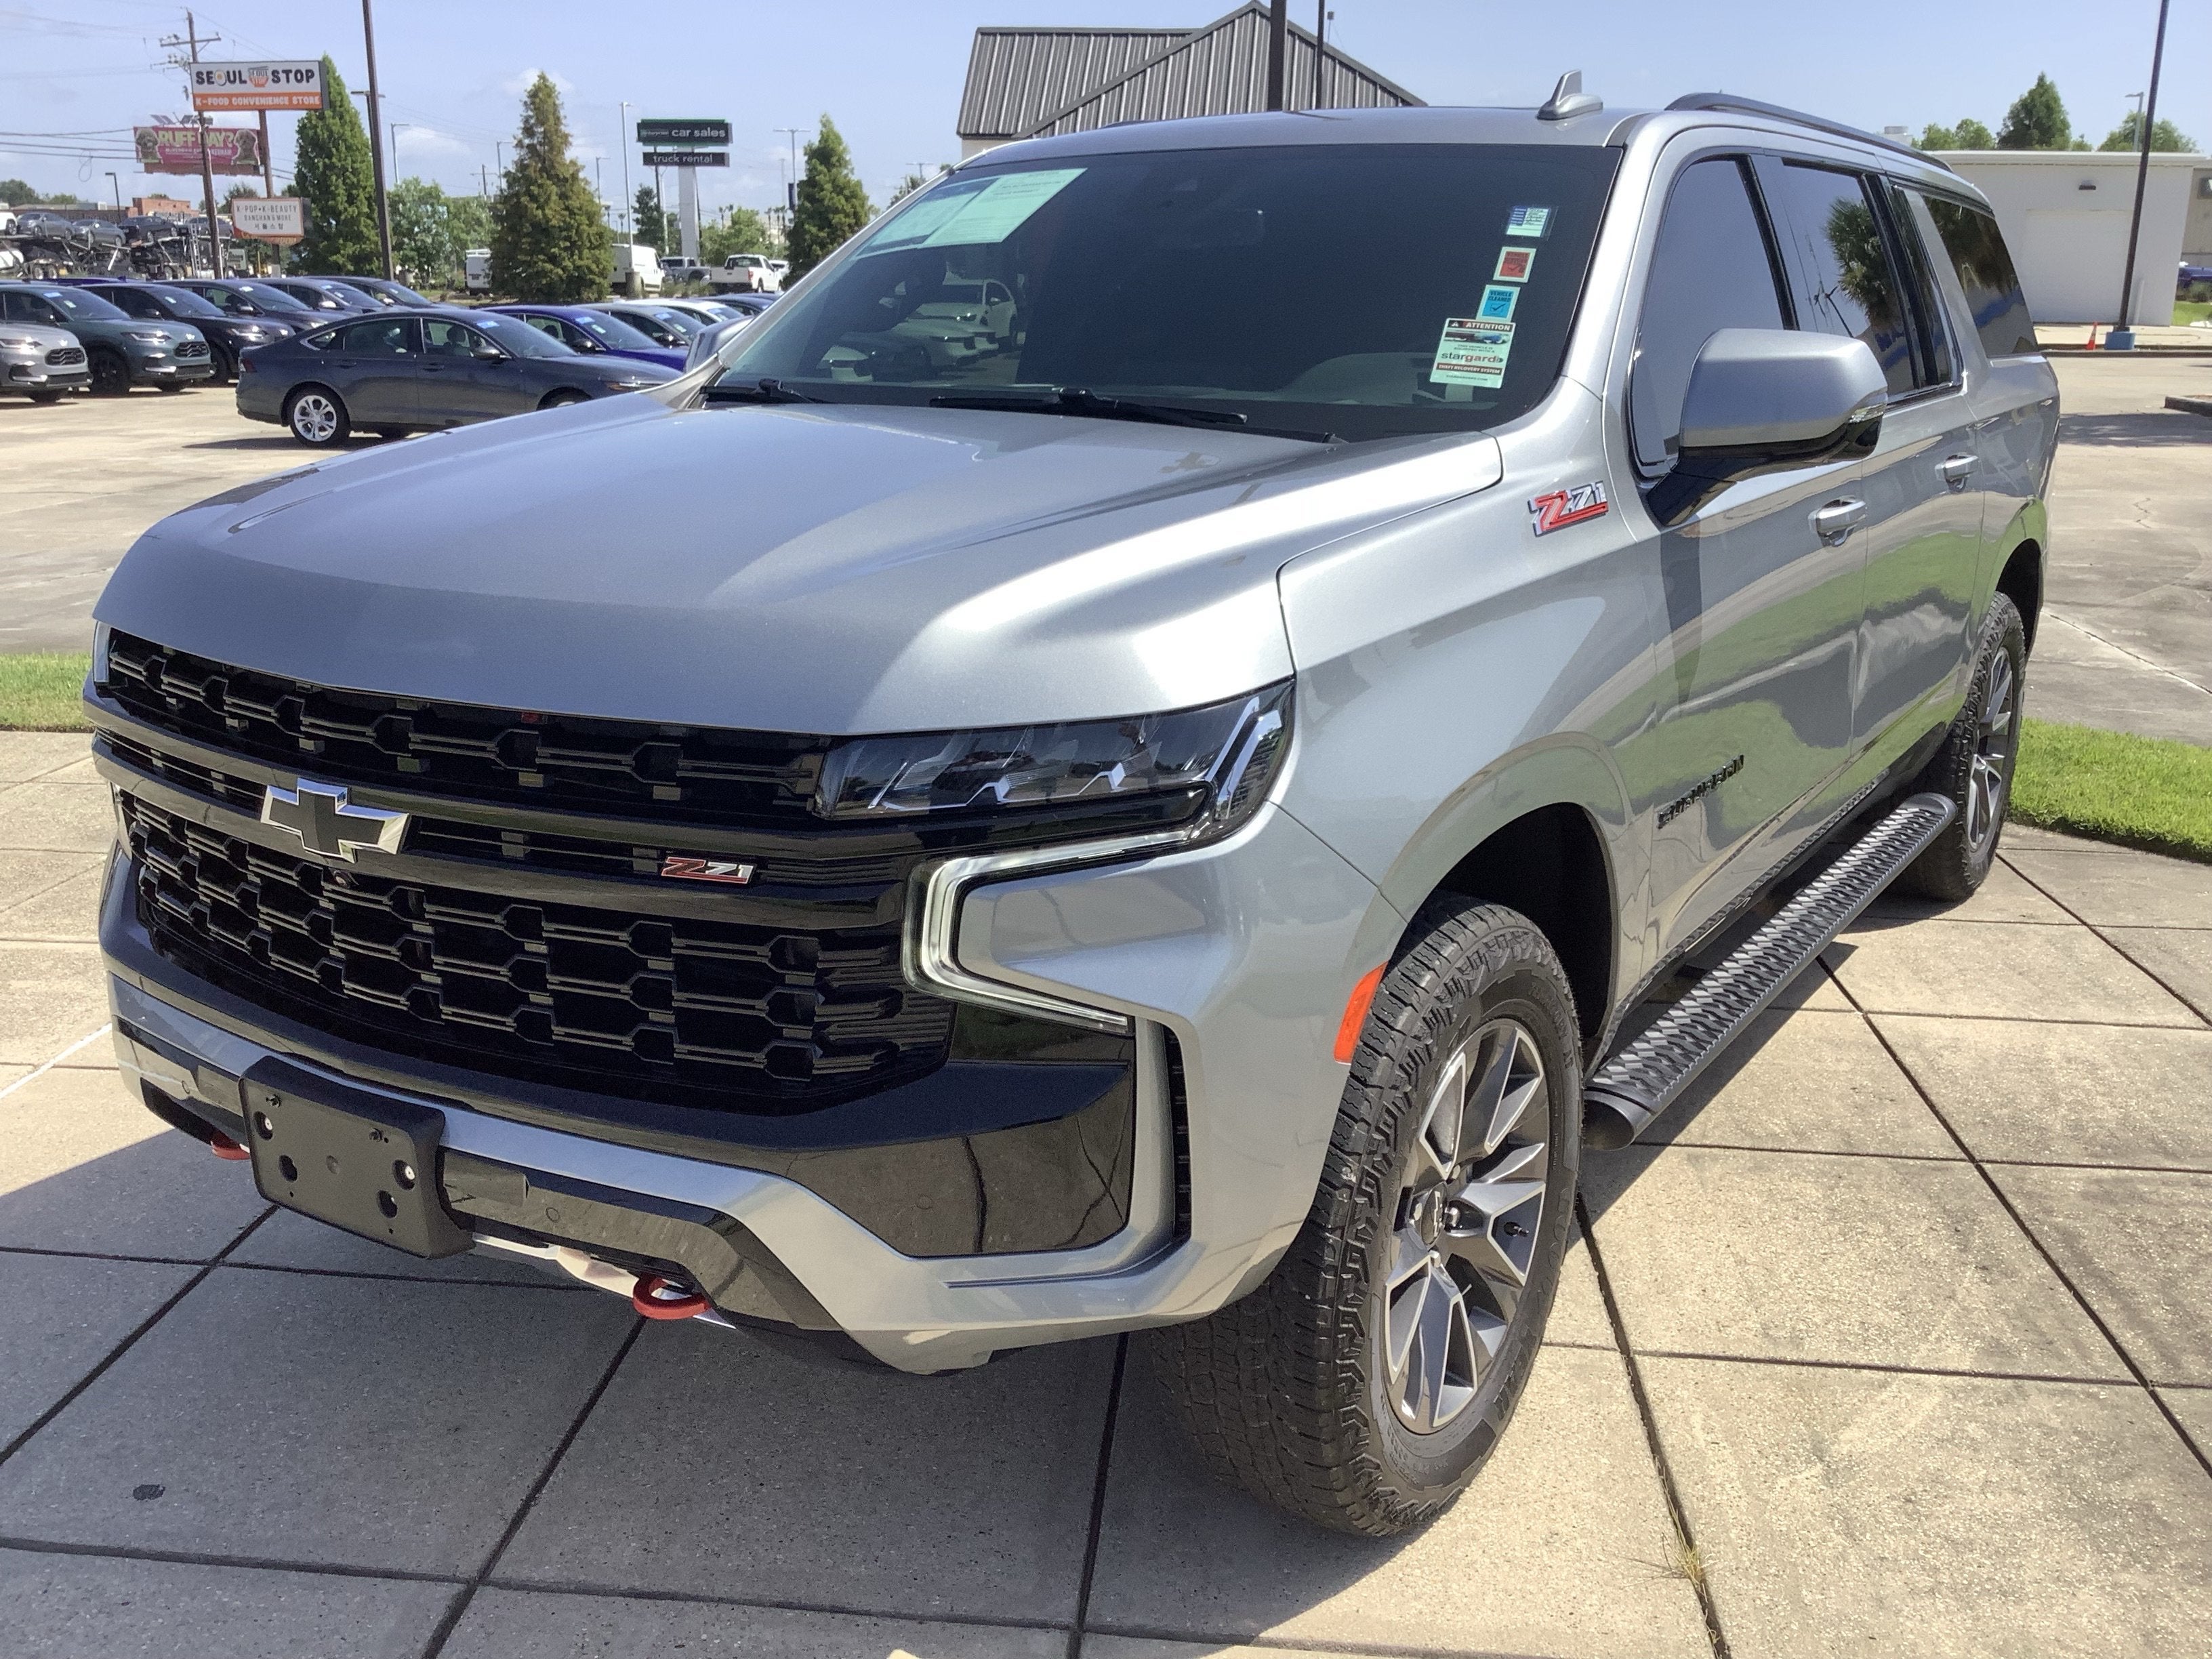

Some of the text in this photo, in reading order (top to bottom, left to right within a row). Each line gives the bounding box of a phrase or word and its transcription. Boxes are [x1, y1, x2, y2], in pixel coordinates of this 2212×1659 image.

[195, 69, 315, 86] SEOUL STOP
[232, 96, 289, 106] CONVENIENCE
[292, 96, 321, 105] STORE
[158, 130, 196, 147] RUFF
[672, 129, 691, 138] car
[693, 127, 726, 138] sales
[653, 154, 713, 163] truck rental
[1466, 322, 1511, 331] ATTENTION
[1528, 480, 1609, 537] Z71
[661, 856, 754, 884] Z71
